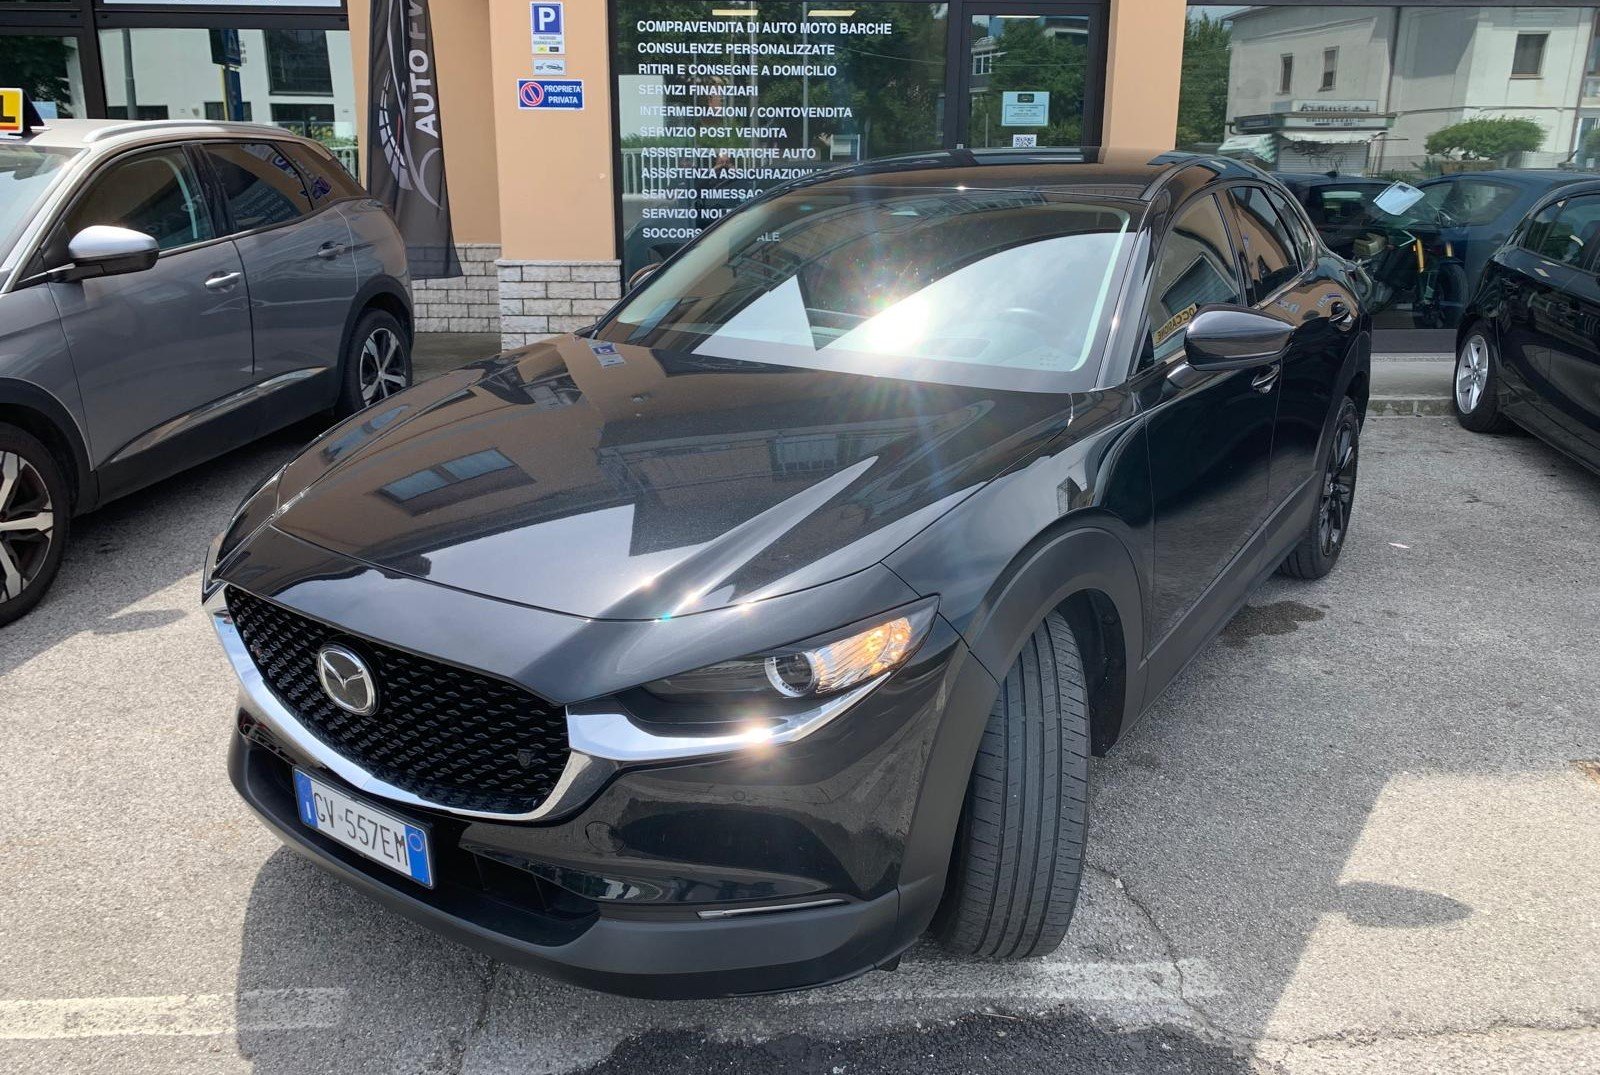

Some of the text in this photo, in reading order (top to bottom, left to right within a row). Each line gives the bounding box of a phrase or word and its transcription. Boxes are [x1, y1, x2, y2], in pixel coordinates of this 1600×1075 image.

[538, 6, 556, 31] P
[637, 20, 892, 35] COMPRAVENDITA DI AUTO MOTO BARCHE
[637, 42, 835, 56] CONSULENZE PERSONALIZZATE
[638, 63, 837, 77] RITIRI E CONSEGNE A DOMICILIO
[409, 49, 439, 139] AUTO
[638, 84, 759, 97] SERVIZI FINANZIARI
[548, 96, 579, 104] PRIVATA
[640, 105, 747, 118] INTERMEDIAZIONI
[757, 106, 853, 118] CONTOVENDITA
[640, 126, 788, 138] SERVIZIO POST VENDITA
[640, 147, 816, 159] ASSISTENZA PRATICHE AUTO
[641, 168, 717, 179] ASSISTENZA
[641, 189, 697, 200] SERVIZIO
[642, 208, 698, 219] SERVIZIO
